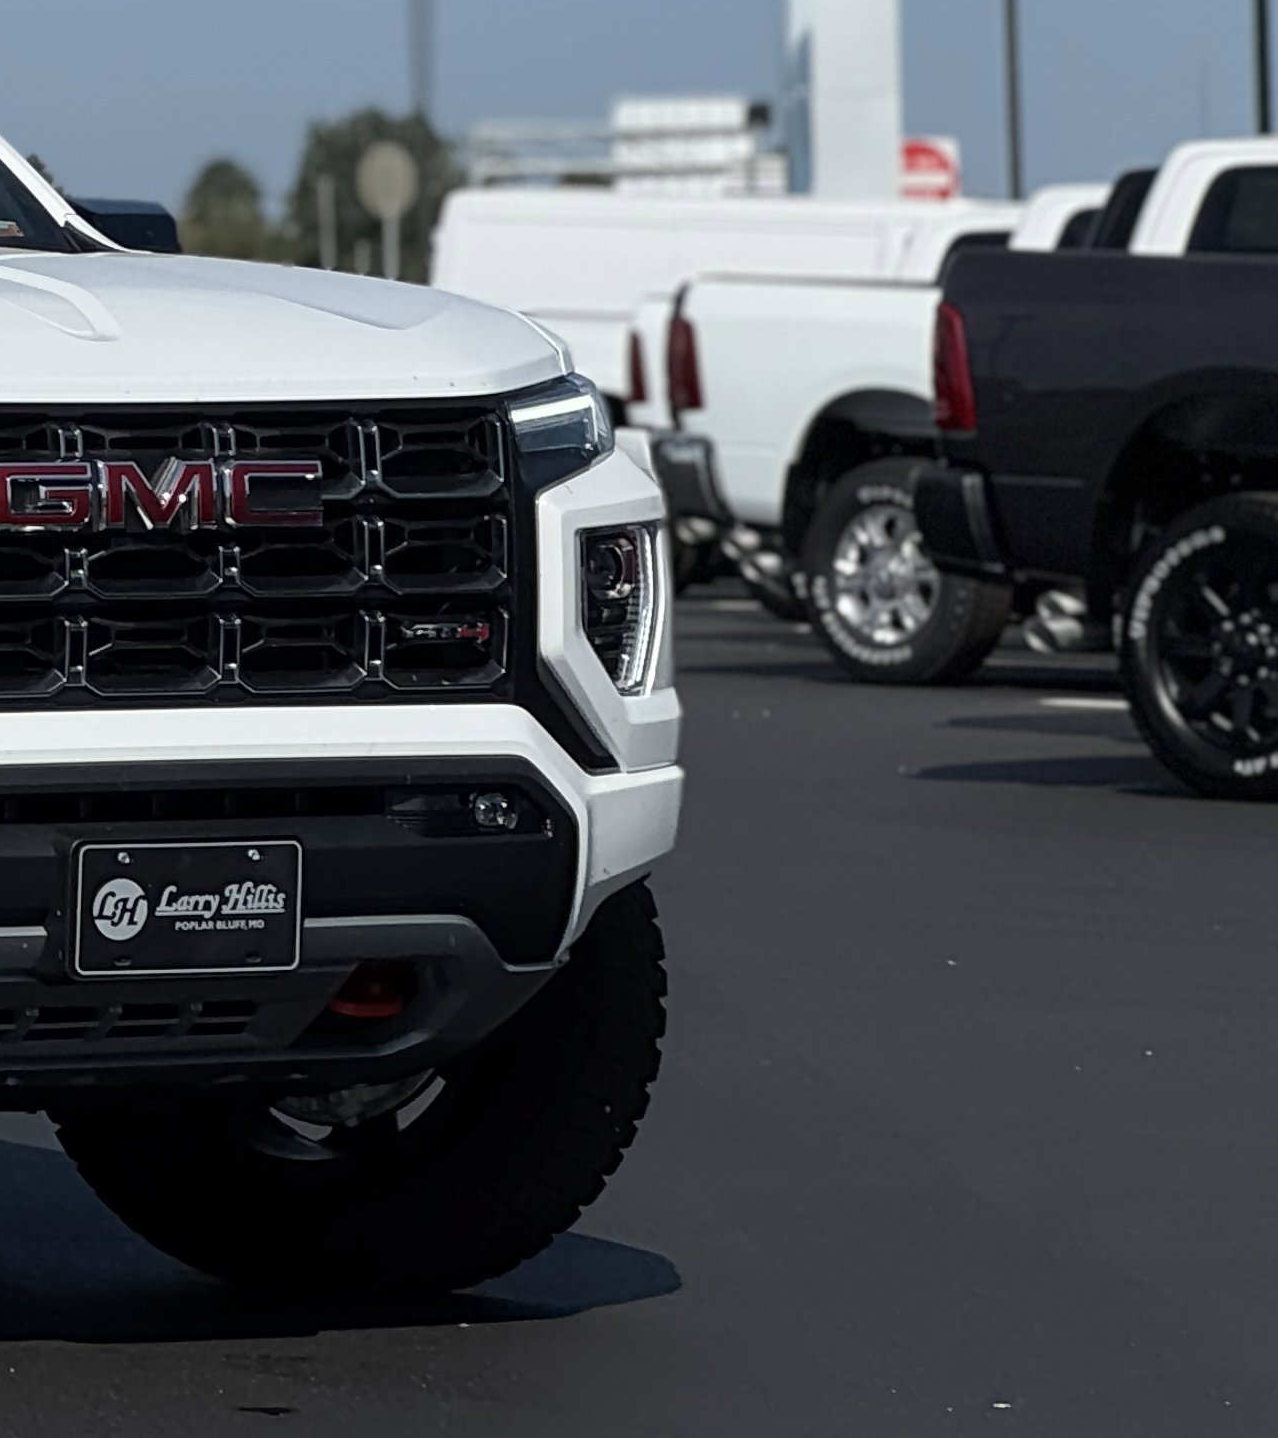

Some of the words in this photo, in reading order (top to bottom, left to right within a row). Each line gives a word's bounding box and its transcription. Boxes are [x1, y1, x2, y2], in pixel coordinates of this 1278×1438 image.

[155, 885, 221, 919] Larry
[221, 881, 286, 912] Hillis
[175, 921, 214, 932] POPLAR
[248, 919, 265, 929] MO
